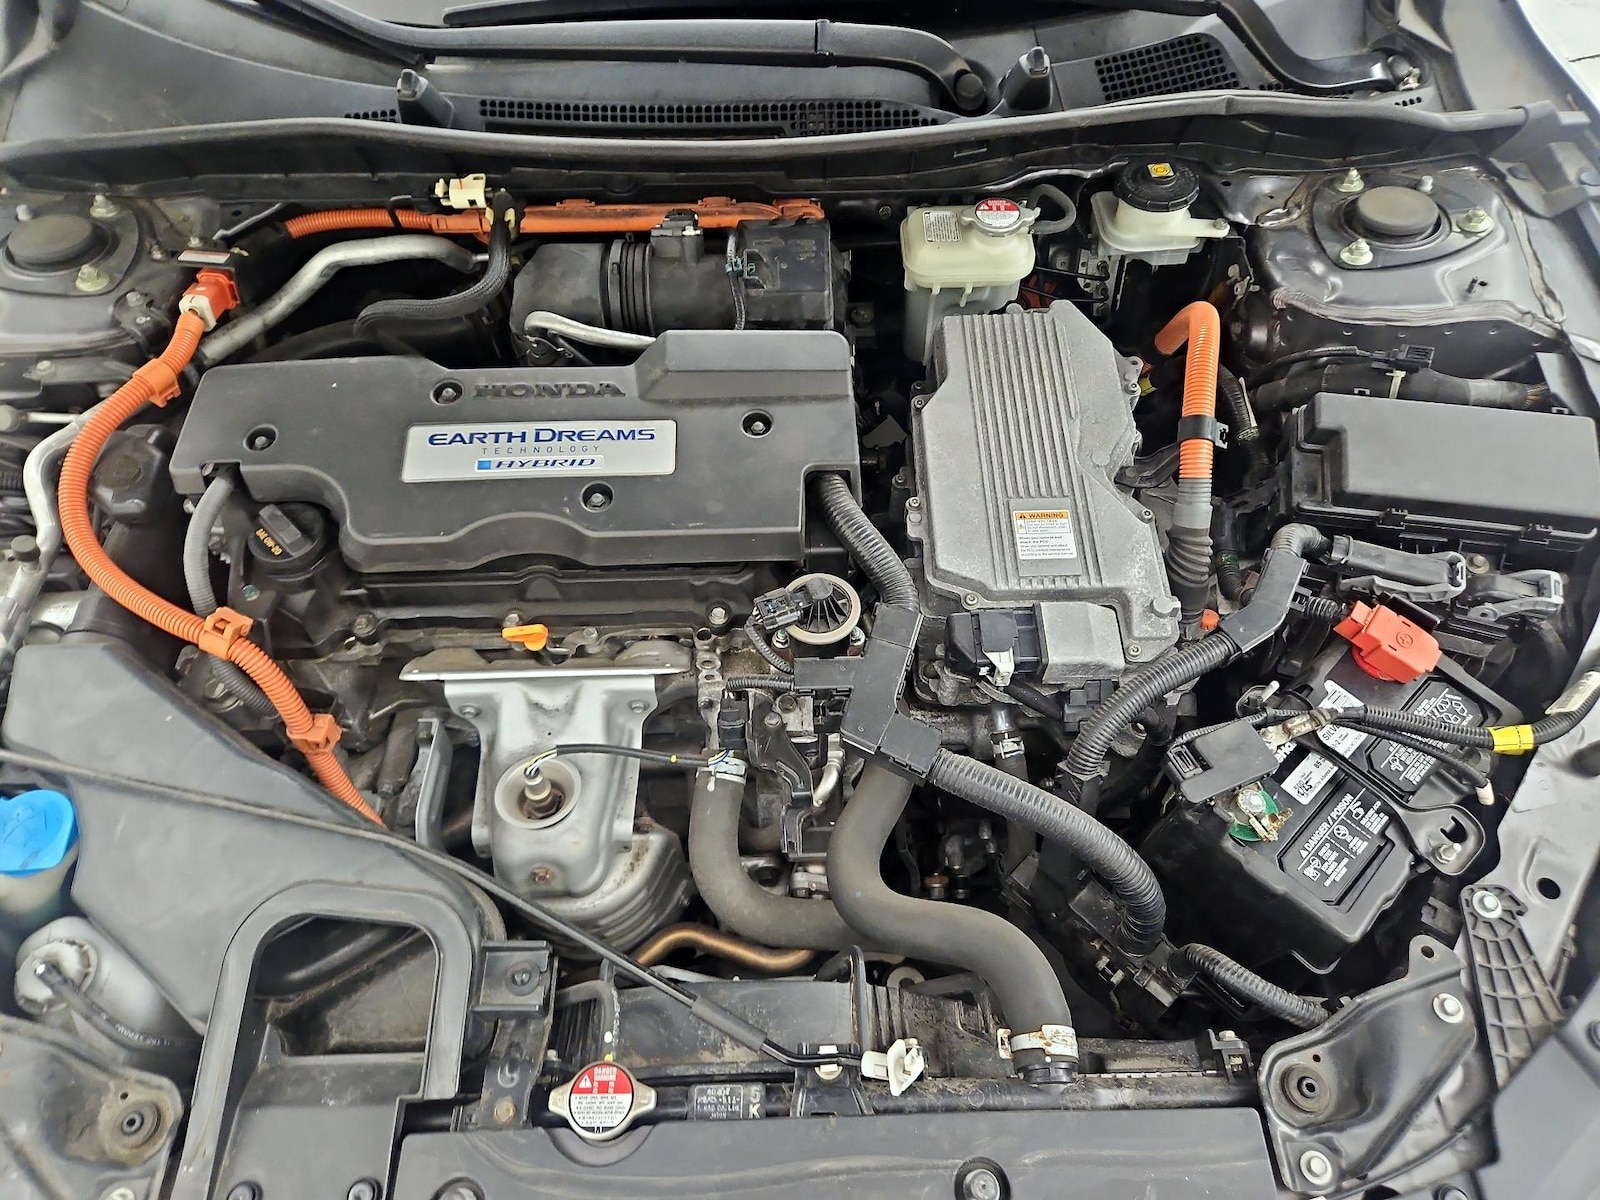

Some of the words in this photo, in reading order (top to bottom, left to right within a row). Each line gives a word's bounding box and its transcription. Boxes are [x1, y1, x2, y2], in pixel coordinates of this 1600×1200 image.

[473, 382, 625, 399] HONDA
[429, 432, 526, 445] EARTH
[534, 428, 655, 444] DREAMS
[483, 446, 600, 455] TECHNOLOGY
[495, 458, 596, 469] HYBRID
[1302, 820, 1330, 851] DANGER
[1329, 792, 1354, 820] POISON
[594, 1067, 617, 1075] DANGER
[749, 1103, 760, 1119] K
